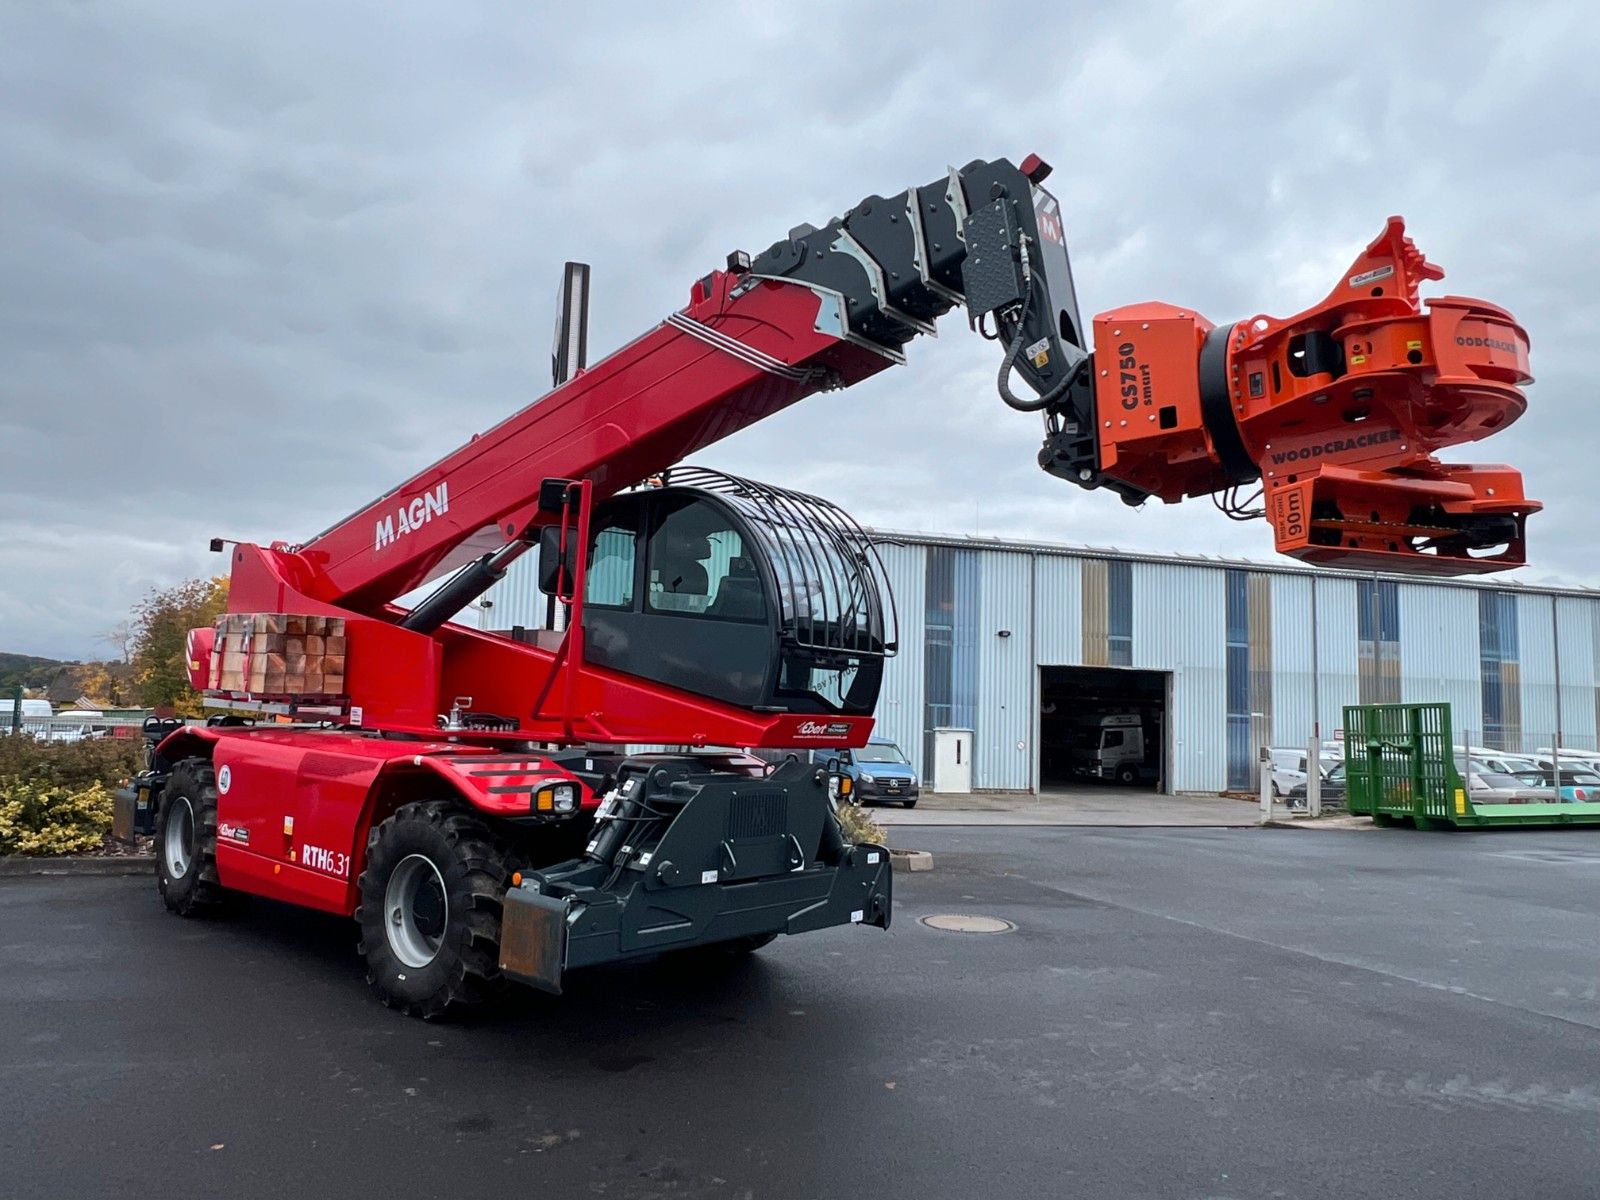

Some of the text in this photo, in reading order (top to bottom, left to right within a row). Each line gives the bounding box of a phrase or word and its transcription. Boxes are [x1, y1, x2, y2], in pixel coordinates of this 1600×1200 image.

[1118, 342, 1139, 410] CS750
[1139, 364, 1152, 406] smart
[1271, 428, 1402, 465] WOODCRACKER
[375, 481, 449, 552] MAGNI
[1287, 493, 1302, 535] 90m
[302, 844, 350, 877] RTH6.31
